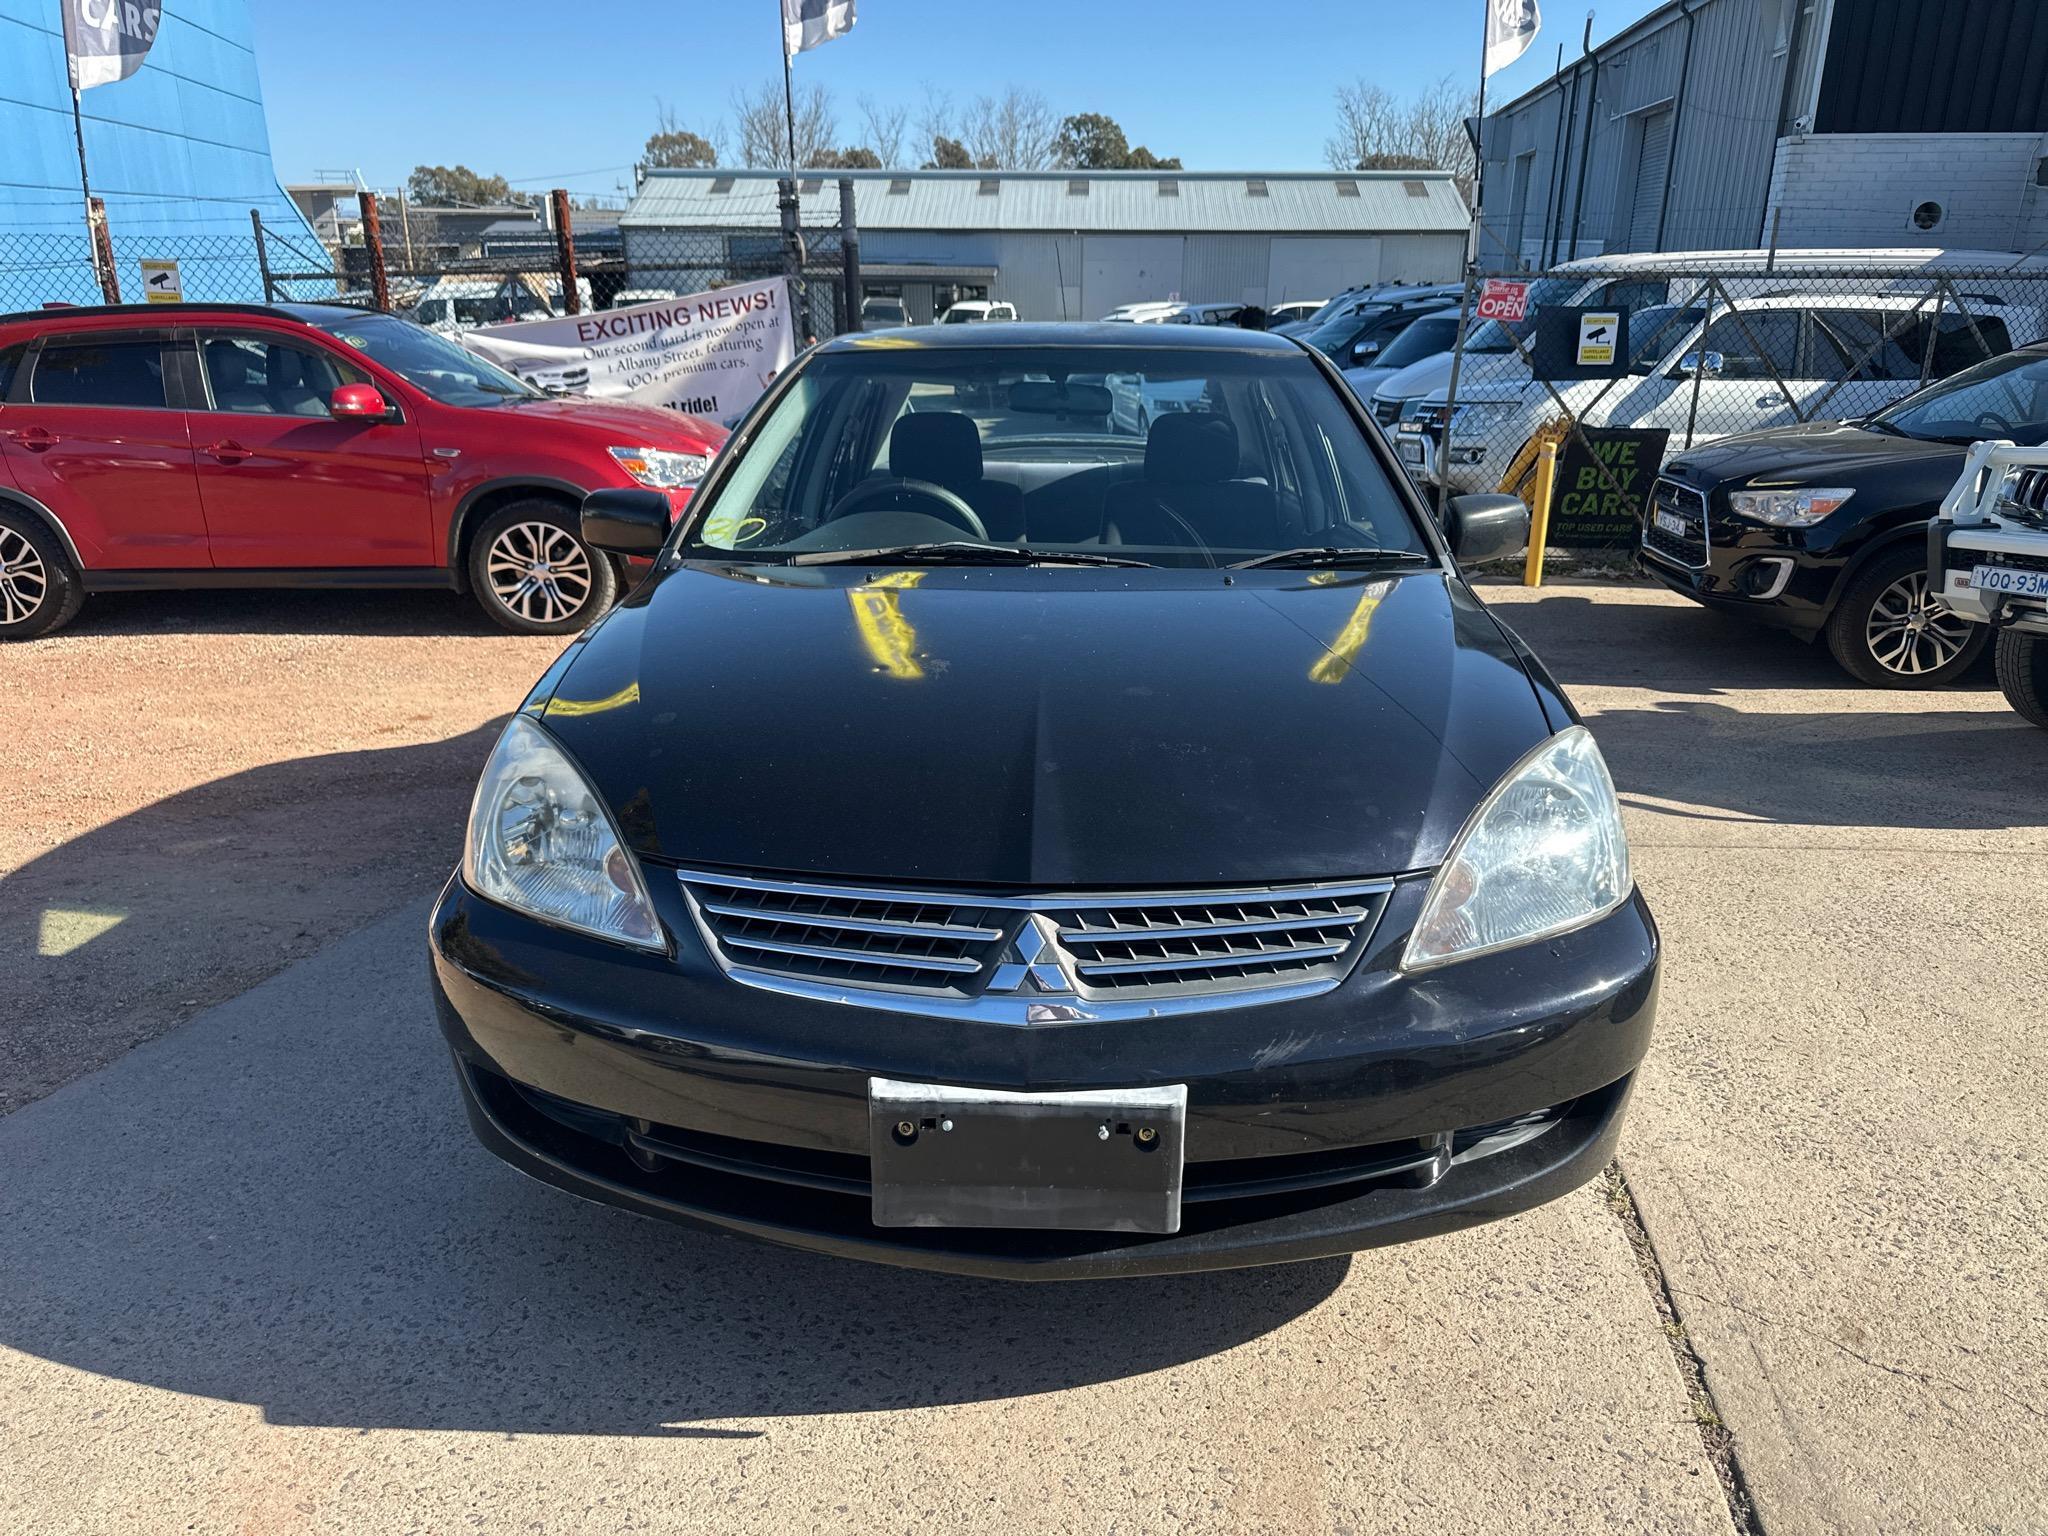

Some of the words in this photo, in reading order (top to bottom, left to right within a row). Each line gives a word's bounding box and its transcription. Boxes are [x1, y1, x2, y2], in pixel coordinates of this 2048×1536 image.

[81, 0, 160, 43] CARS
[577, 307, 691, 342] EXCITING
[698, 289, 776, 322] NEWS!
[1481, 298, 1525, 317] OPEN
[583, 347, 611, 360] Our
[614, 335, 657, 356] second
[661, 329, 689, 351] yard
[691, 328, 702, 341] is
[705, 324, 732, 339] now
[735, 318, 765, 335] open
[768, 317, 779, 328] at
[616, 356, 661, 372] Albany
[706, 336, 764, 353] featuring
[663, 360, 717, 382] premium
[720, 358, 750, 370] cars.
[681, 396, 719, 414] ride!
[1594, 441, 1641, 464] WE
[1576, 466, 1639, 490] BUY
[1561, 492, 1641, 516] CARS
[1577, 523, 1604, 532] USED
[1606, 524, 1633, 532] CARS
